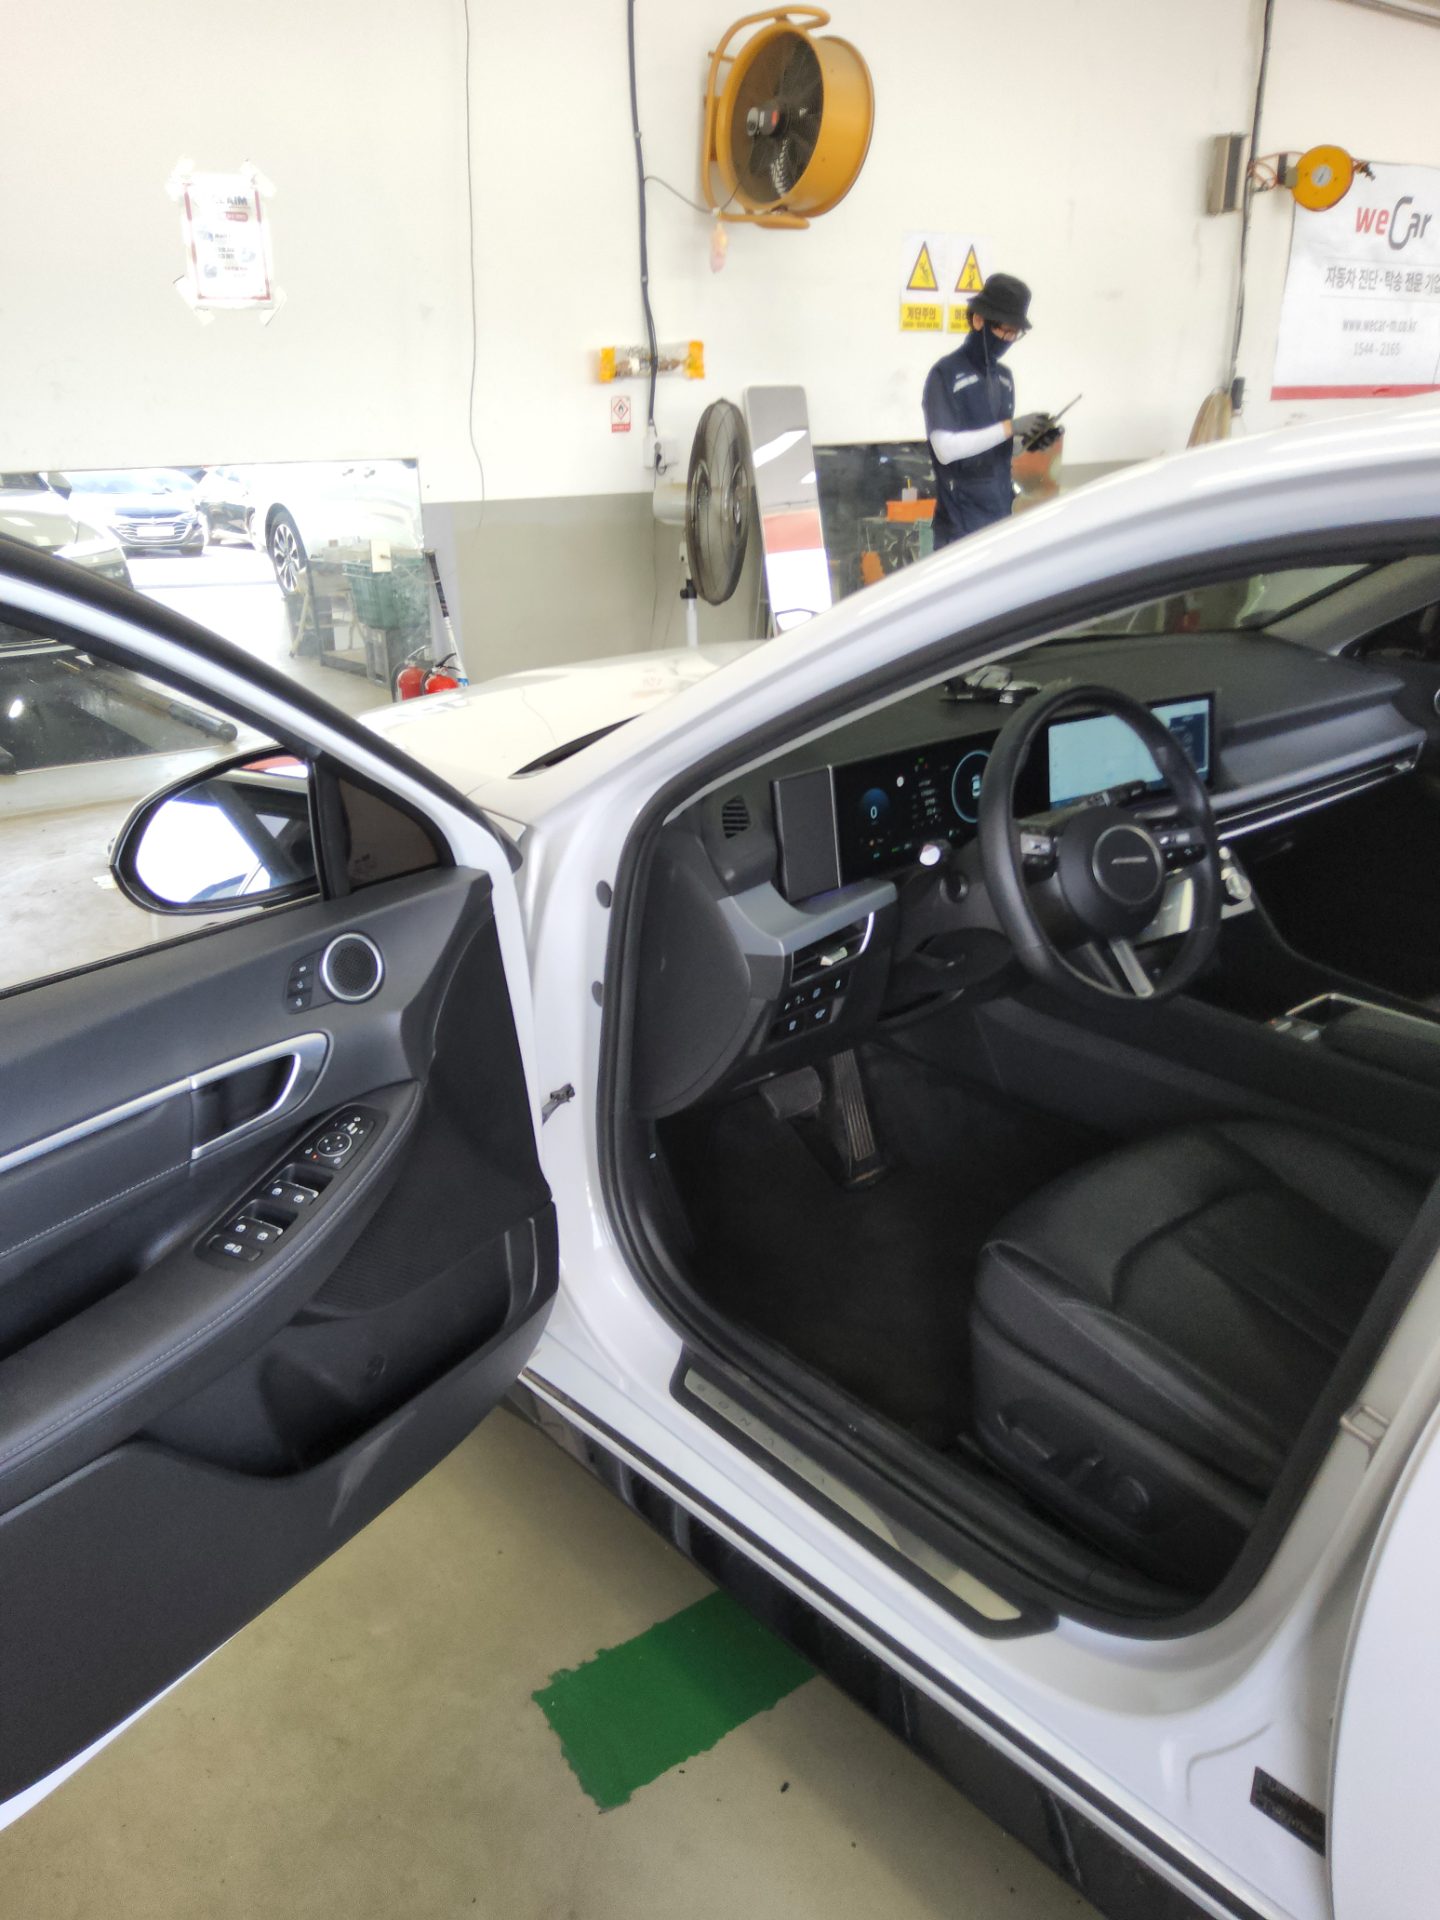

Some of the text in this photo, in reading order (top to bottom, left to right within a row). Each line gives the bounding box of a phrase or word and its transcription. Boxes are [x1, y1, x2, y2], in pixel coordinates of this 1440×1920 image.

[1355, 196, 1433, 250] weCar
[1325, 266, 1357, 289] 자동차
[1404, 271, 1424, 294] 전문
